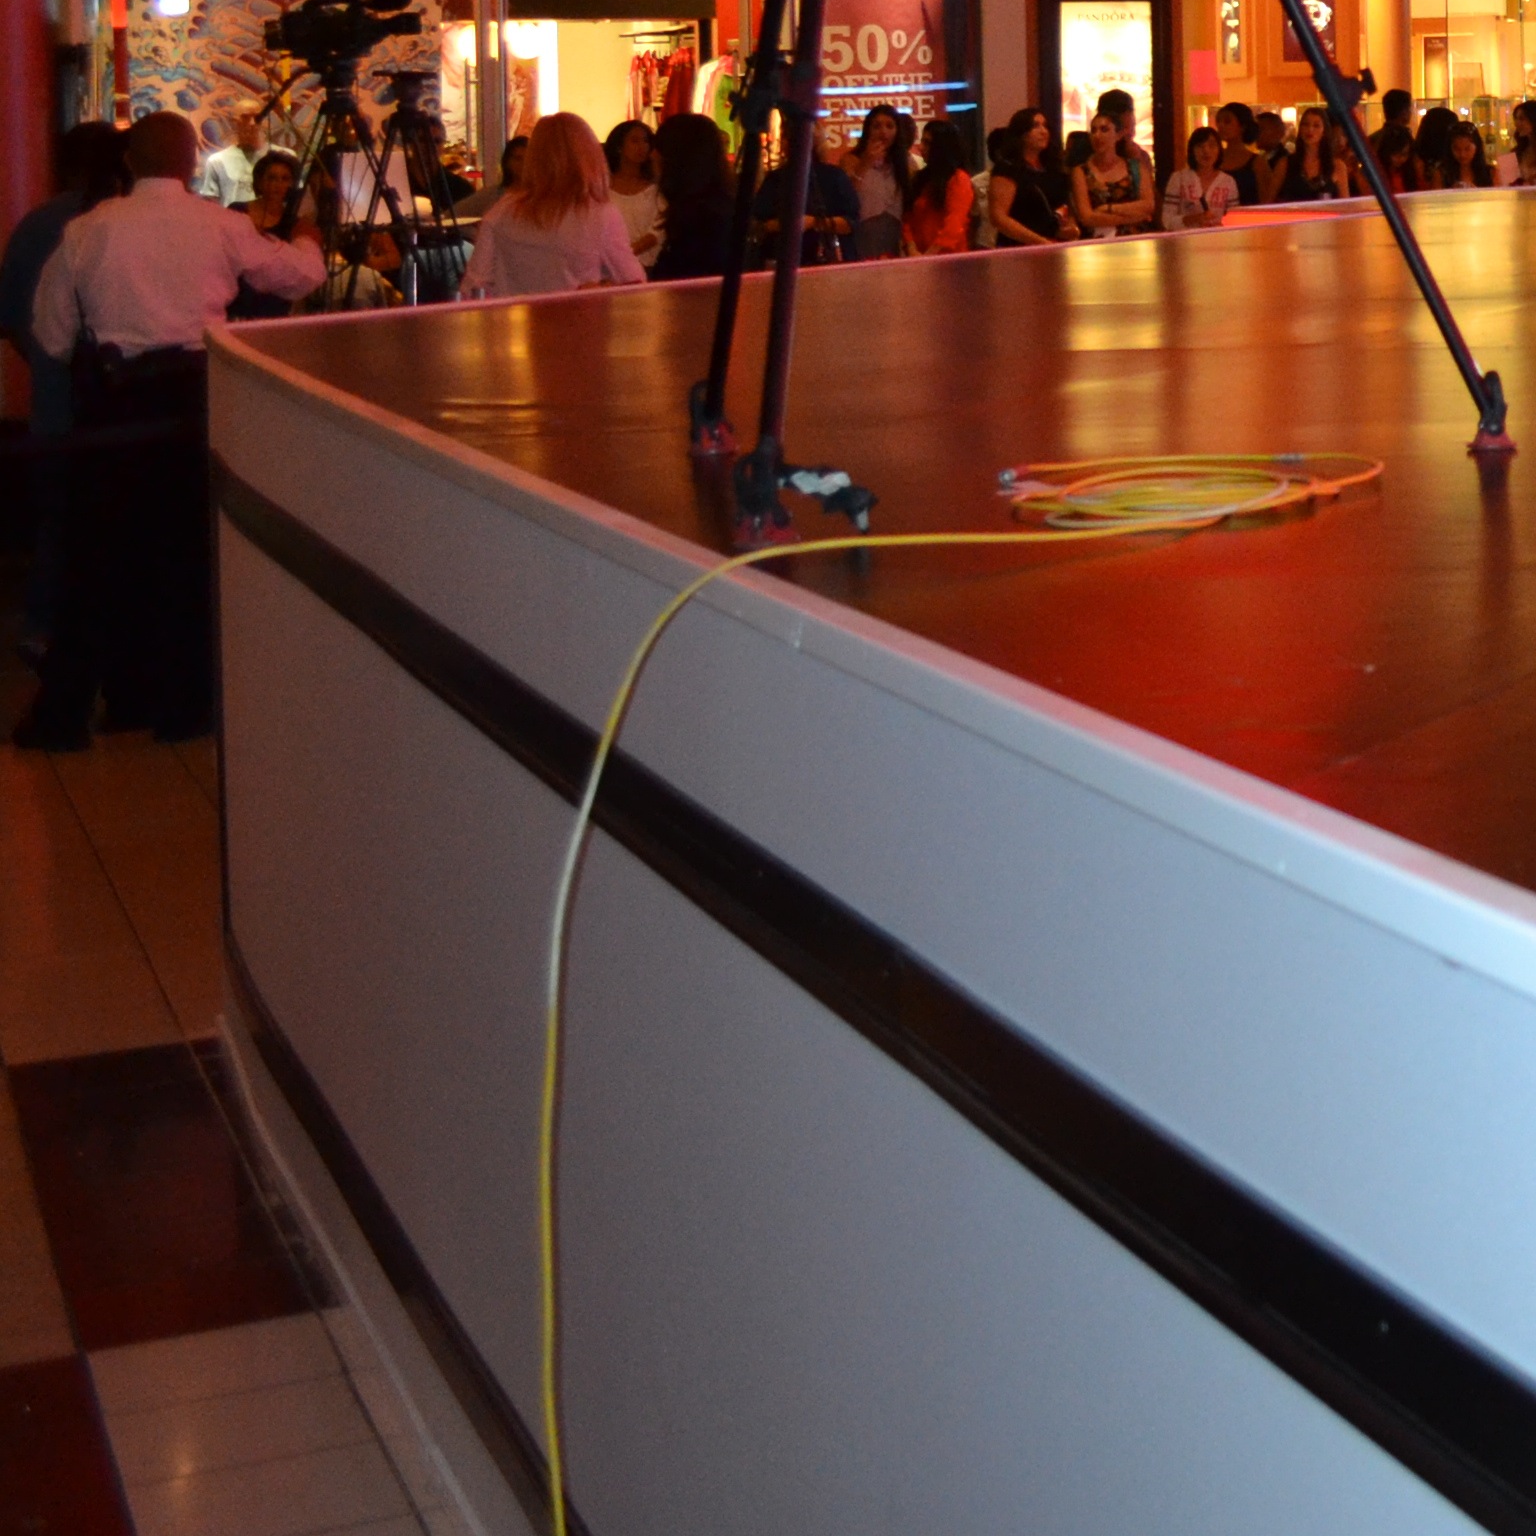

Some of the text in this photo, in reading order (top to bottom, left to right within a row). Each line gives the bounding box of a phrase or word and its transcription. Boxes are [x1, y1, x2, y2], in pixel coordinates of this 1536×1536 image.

[1077, 11, 1136, 22] PANDORA
[820, 24, 933, 73] 50%
[822, 72, 934, 95] OFF THE
[823, 95, 936, 122] ENRE
